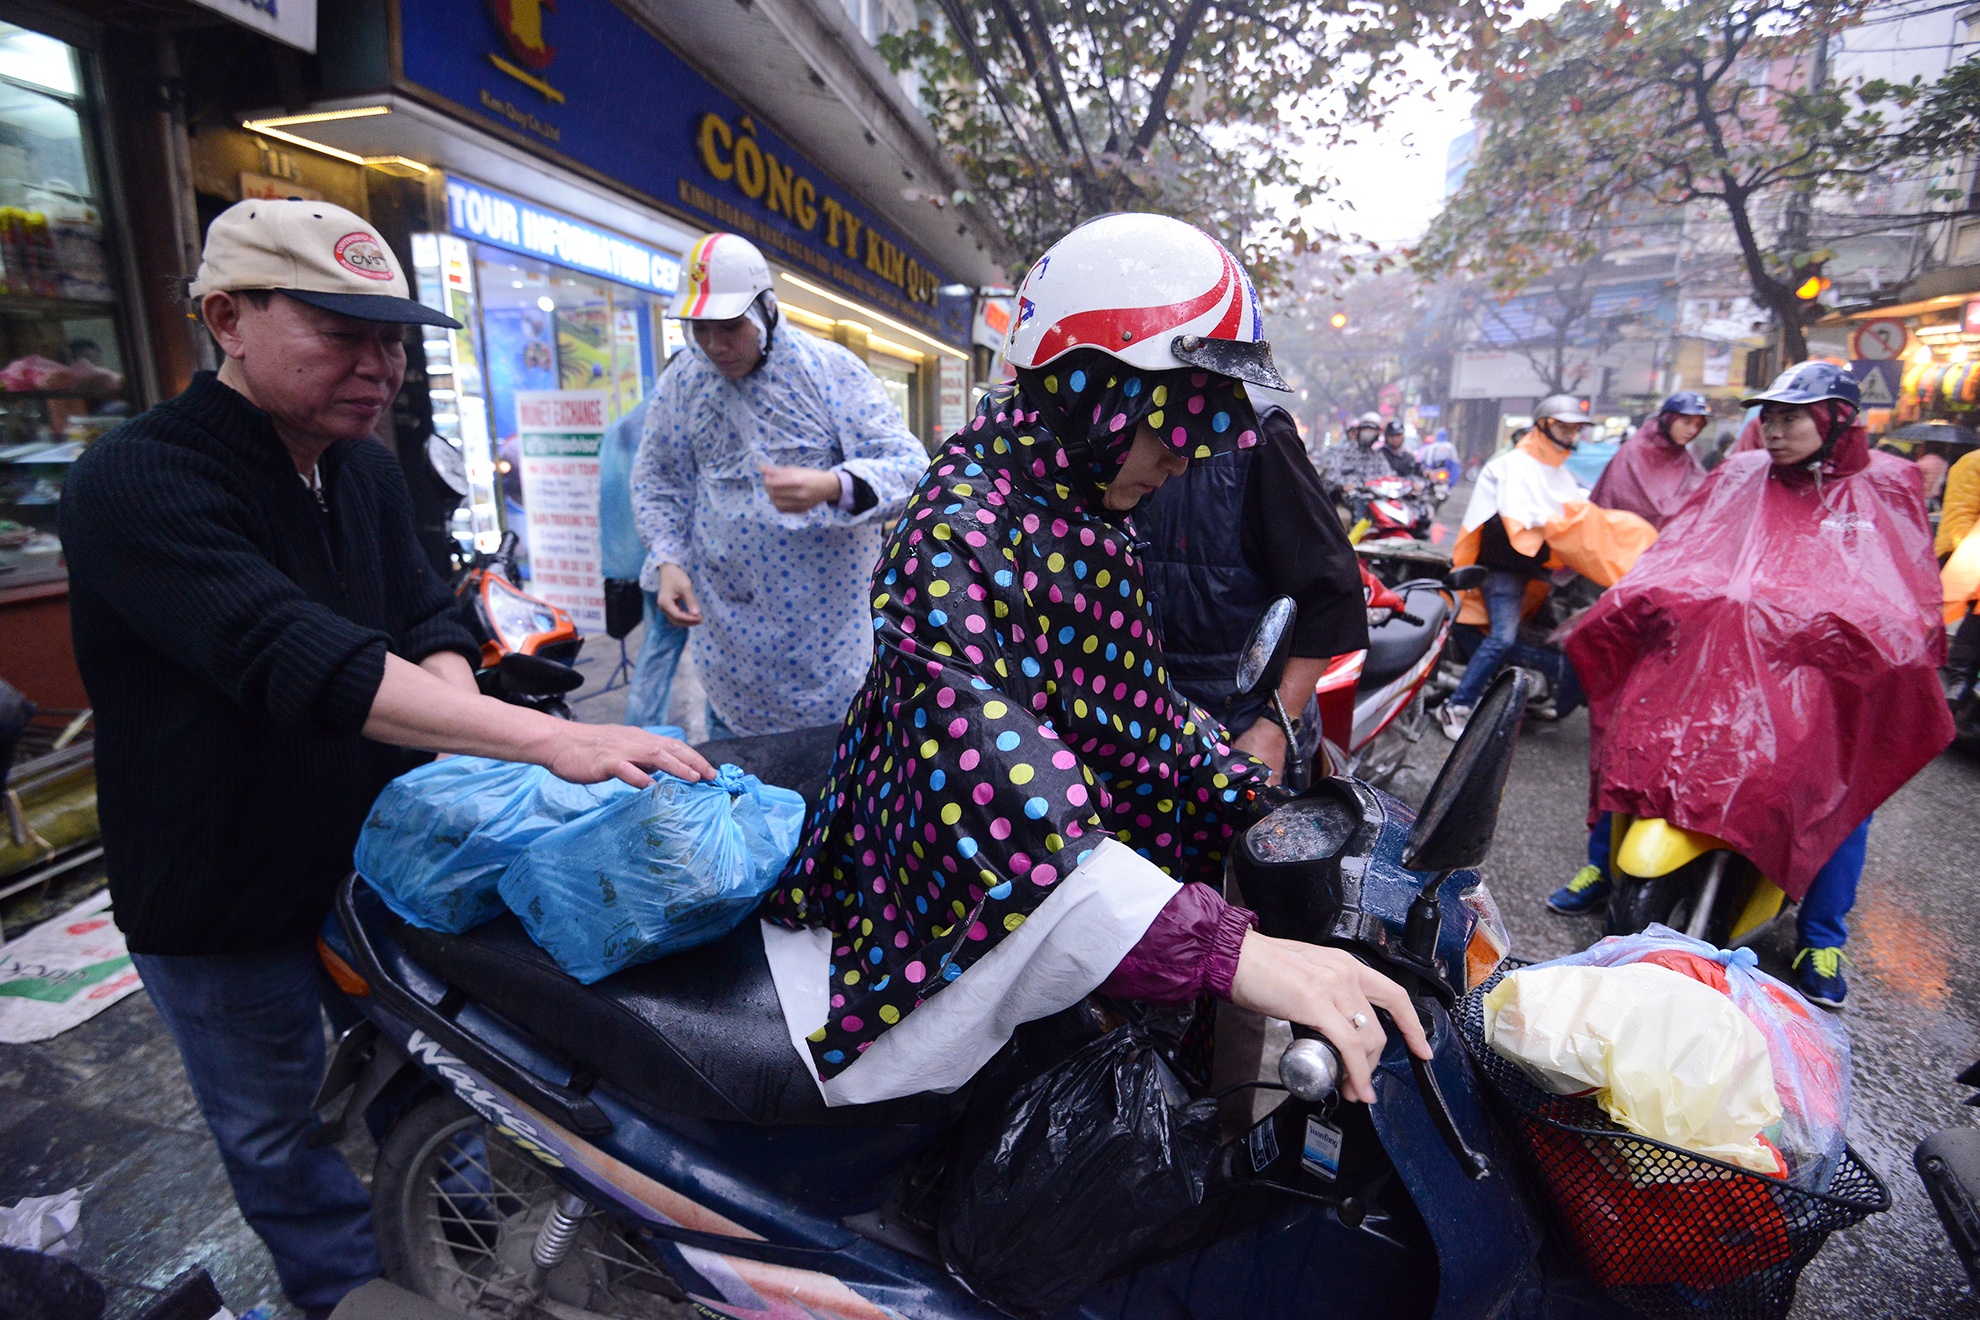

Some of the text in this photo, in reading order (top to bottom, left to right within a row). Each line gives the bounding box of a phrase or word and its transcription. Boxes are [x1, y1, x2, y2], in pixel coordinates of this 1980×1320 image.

[448, 182, 519, 245] TOUR
[521, 208, 650, 285] INFORMATION
[699, 112, 817, 231] CÔNG
[822, 195, 862, 259] TY
[865, 227, 905, 288] KIM
[553, 399, 603, 428] EXCHANGE
[407, 1029, 561, 1156] Wave
[454, 1087, 494, 1123] HONDA
